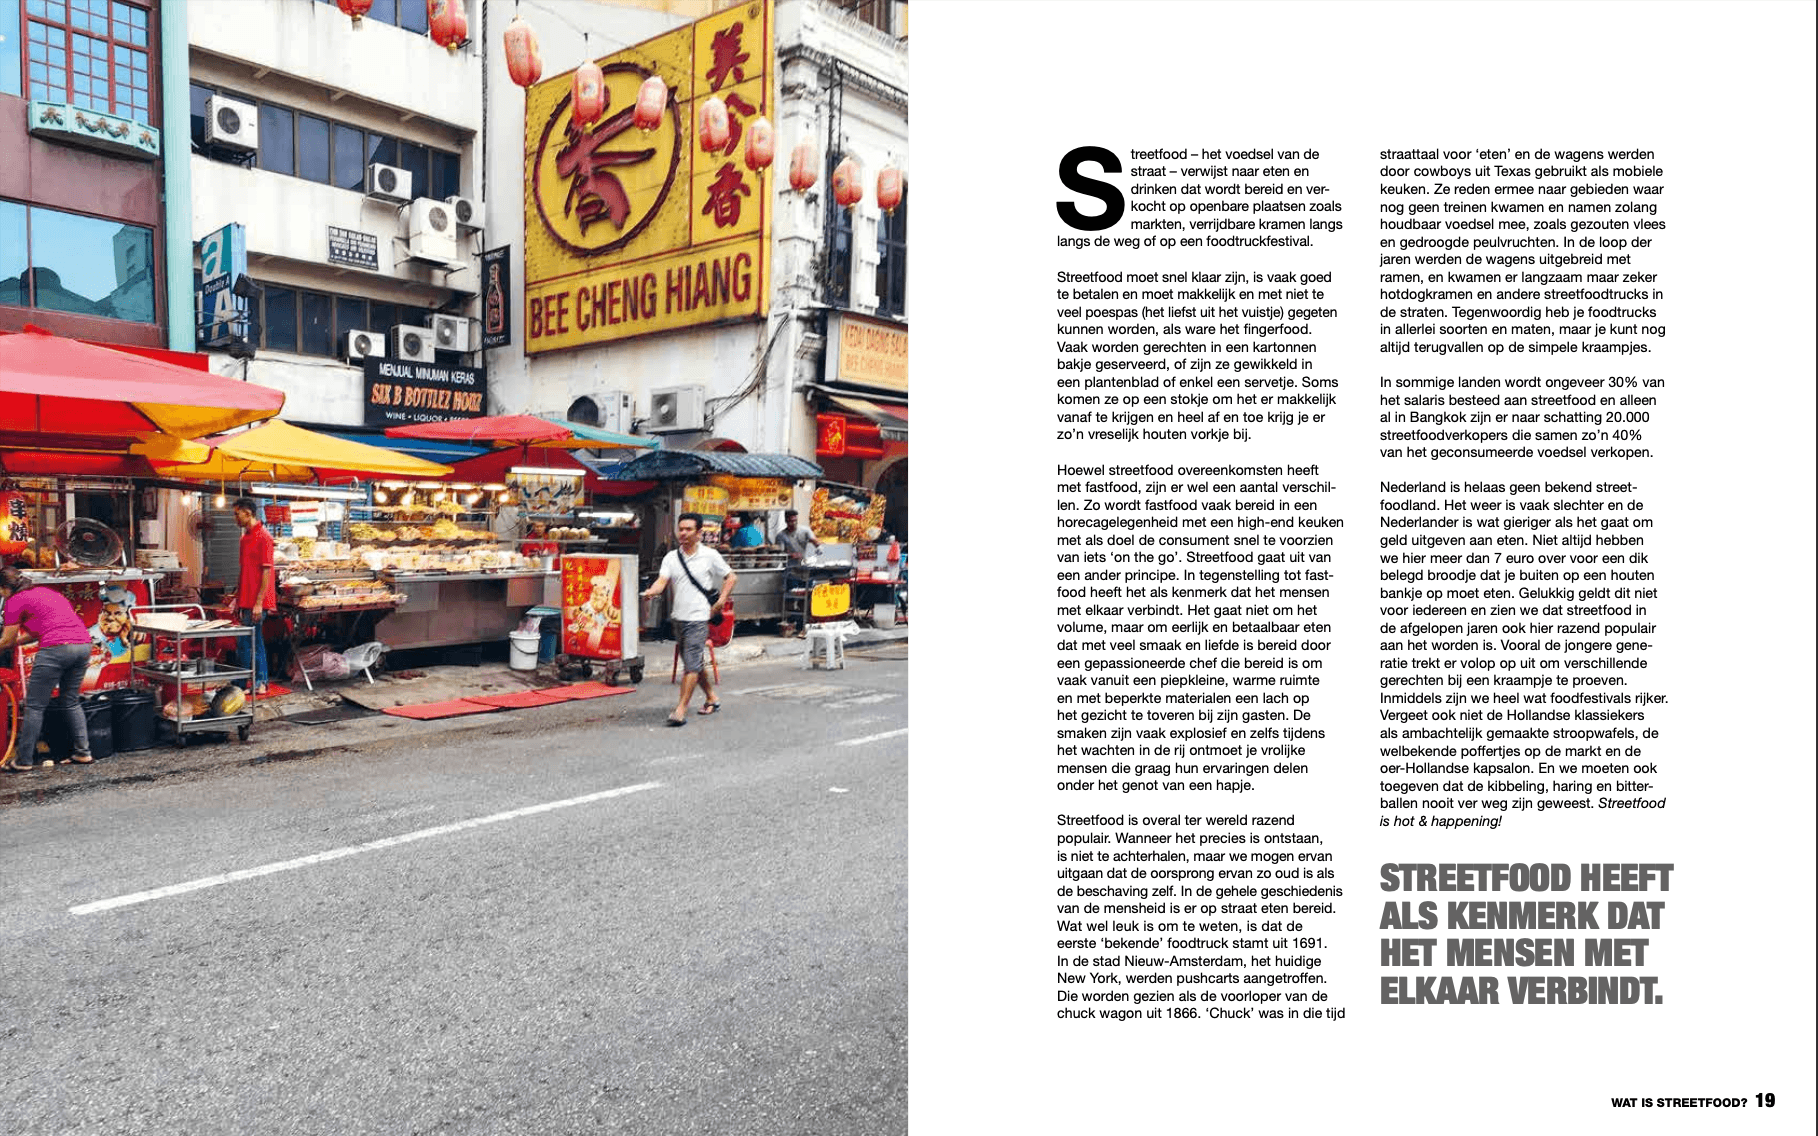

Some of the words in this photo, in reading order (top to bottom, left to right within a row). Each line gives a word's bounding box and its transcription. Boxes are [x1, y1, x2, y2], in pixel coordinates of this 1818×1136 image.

[1379, 165, 1411, 177] door
[1413, 165, 1472, 180] cowboys
[1475, 165, 1491, 177] uit
[1493, 165, 1532, 177] Texas
[1534, 165, 1588, 180] gebruikt
[1590, 165, 1610, 177] als
[1612, 165, 1664, 177] mobiele
[1056, 145, 1126, 232] S
[1130, 183, 1177, 195] drinken
[1180, 183, 1202, 195] dat
[1204, 183, 1241, 195] wordt
[1244, 183, 1284, 195] bereid
[1286, 185, 1303, 195] en
[1305, 185, 1330, 195] ver-
[1130, 200, 1167, 212] kocht
[1169, 202, 1186, 215] op
[1189, 200, 1250, 215] openbare
[1252, 200, 1306, 215] plaatsen
[1308, 200, 1343, 212] zoals
[1057, 270, 1123, 283] Streetfood
[1126, 271, 1159, 283] moet
[1161, 271, 1188, 283] snel
[1191, 271, 1222, 283] klaar
[1224, 271, 1249, 286] zijn,
[1253, 271, 1264, 283] is
[1266, 271, 1297, 283] vaak
[1299, 271, 1332, 286] goed
[530, 291, 570, 339] BEE
[577, 272, 657, 332] CHENG
[664, 252, 752, 314] HIANG
[1380, 288, 1473, 303] hotdogkramen
[1476, 290, 1493, 300] en
[1496, 288, 1541, 300] andere
[1543, 287, 1649, 300] streetfoodtrucks
[1652, 288, 1664, 300] in
[211, 287, 234, 340] A
[1056, 341, 1089, 353] Vaak
[1091, 341, 1139, 353] worden
[1142, 341, 1207, 356] gerechten
[1210, 341, 1222, 353] in
[1225, 343, 1249, 353] een
[1252, 341, 1317, 353] kartonnen
[379, 362, 413, 379] MENJUAL
[415, 366, 449, 382] MINUMAN
[450, 370, 475, 385] KERAS
[1380, 376, 1392, 388] In
[1395, 376, 1455, 391] sommige
[1458, 376, 1501, 388] landen
[1504, 376, 1542, 388] wordt
[1545, 378, 1606, 391] ongeveer
[1608, 375, 1638, 388] 30%
[1642, 378, 1665, 388] van
[392, 385, 403, 406] B
[385, 411, 406, 421] WINE
[413, 413, 443, 422] LIQUOR
[1056, 428, 1084, 440] zo’n
[1087, 428, 1140, 443] vreselijk
[1142, 428, 1187, 440] houten
[1190, 428, 1230, 443] vorkje
[1233, 428, 1252, 443] bij.
[1379, 428, 1509, 444] streetfoodverkopers
[1511, 429, 1532, 441] die
[1534, 431, 1578, 441] samen
[1581, 429, 1609, 441] zo’n
[1612, 428, 1642, 441] 40%
[1057, 464, 1105, 476] Hoewel
[1108, 463, 1174, 476] streetfood
[1177, 464, 1283, 476] overeenkomsten
[1287, 463, 1320, 476] heeft
[1380, 481, 1446, 493] Nederland
[1450, 481, 1461, 493] is
[1464, 481, 1506, 493] helaas
[1509, 483, 1541, 496] geen
[1544, 481, 1592, 493] bekend
[1595, 481, 1638, 493] street-
[1057, 516, 1178, 531] horecagelegenheid
[1182, 516, 1207, 528] met
[1210, 518, 1234, 528] een
[1237, 516, 1294, 531] high-end
[1298, 516, 1344, 528] keuken
[1056, 659, 1081, 669] een
[1084, 657, 1186, 672] gepassioneerde
[1189, 656, 1218, 669] chef
[1220, 657, 1241, 669] die
[1244, 657, 1284, 669] bereid
[1288, 657, 1299, 669] is
[1301, 659, 1323, 669] om
[1380, 692, 1443, 704] Inmiddels
[1445, 692, 1467, 707] zijn
[1470, 694, 1490, 704] we
[1493, 692, 1520, 704] heel
[1523, 692, 1547, 704] wat
[1549, 691, 1632, 704] foodfestivals
[1635, 692, 1669, 707] rijker.
[1379, 727, 1399, 739] als
[1401, 727, 1483, 742] ambachtelijk
[1486, 727, 1550, 742] gemaakte
[1552, 726, 1639, 742] stroopwafels,
[1642, 727, 1659, 739] de
[1379, 762, 1470, 774] oer-Hollandse
[1473, 762, 1534, 777] kapsalon.
[1538, 762, 1555, 774] En
[1558, 764, 1578, 774] we
[1581, 762, 1630, 774] moeten
[1633, 762, 1658, 774] ook
[1057, 813, 1124, 826] Streetfood
[1128, 814, 1139, 826] is
[1142, 814, 1181, 826] overal
[1184, 814, 1203, 826] ter
[1205, 814, 1248, 826] wereld
[1251, 814, 1295, 826] razend
[1379, 862, 1572, 892] STREETFOOD
[1580, 863, 1675, 892] HEEFT
[1379, 900, 1439, 930] ALS
[1447, 901, 1600, 930] KENMERK
[1607, 901, 1666, 930] DAT
[1380, 938, 1438, 967] HET
[1446, 937, 1575, 967] MENSEN
[1584, 938, 1650, 967] MET
[1057, 955, 1069, 967] In
[1072, 955, 1089, 967] de
[1092, 955, 1121, 967] stad
[1124, 955, 1247, 969] Nieuw-Amsterdam,
[1251, 955, 1272, 967] het
[1275, 955, 1322, 970] huidige
[1057, 972, 1087, 984] New
[1089, 972, 1122, 986] York,
[1125, 972, 1173, 984] werden
[1176, 972, 1240, 987] pushcarts
[1243, 971, 1327, 987] aangetroffen.
[1380, 976, 1500, 1005] ELKAAR
[1506, 976, 1663, 1005] VERBINDT.
[1610, 1097, 1638, 1108] WAT
[1641, 1097, 1654, 1108] IS
[1656, 1097, 1748, 1108] STREETFOOD?
[1755, 1092, 1776, 1108] 19
